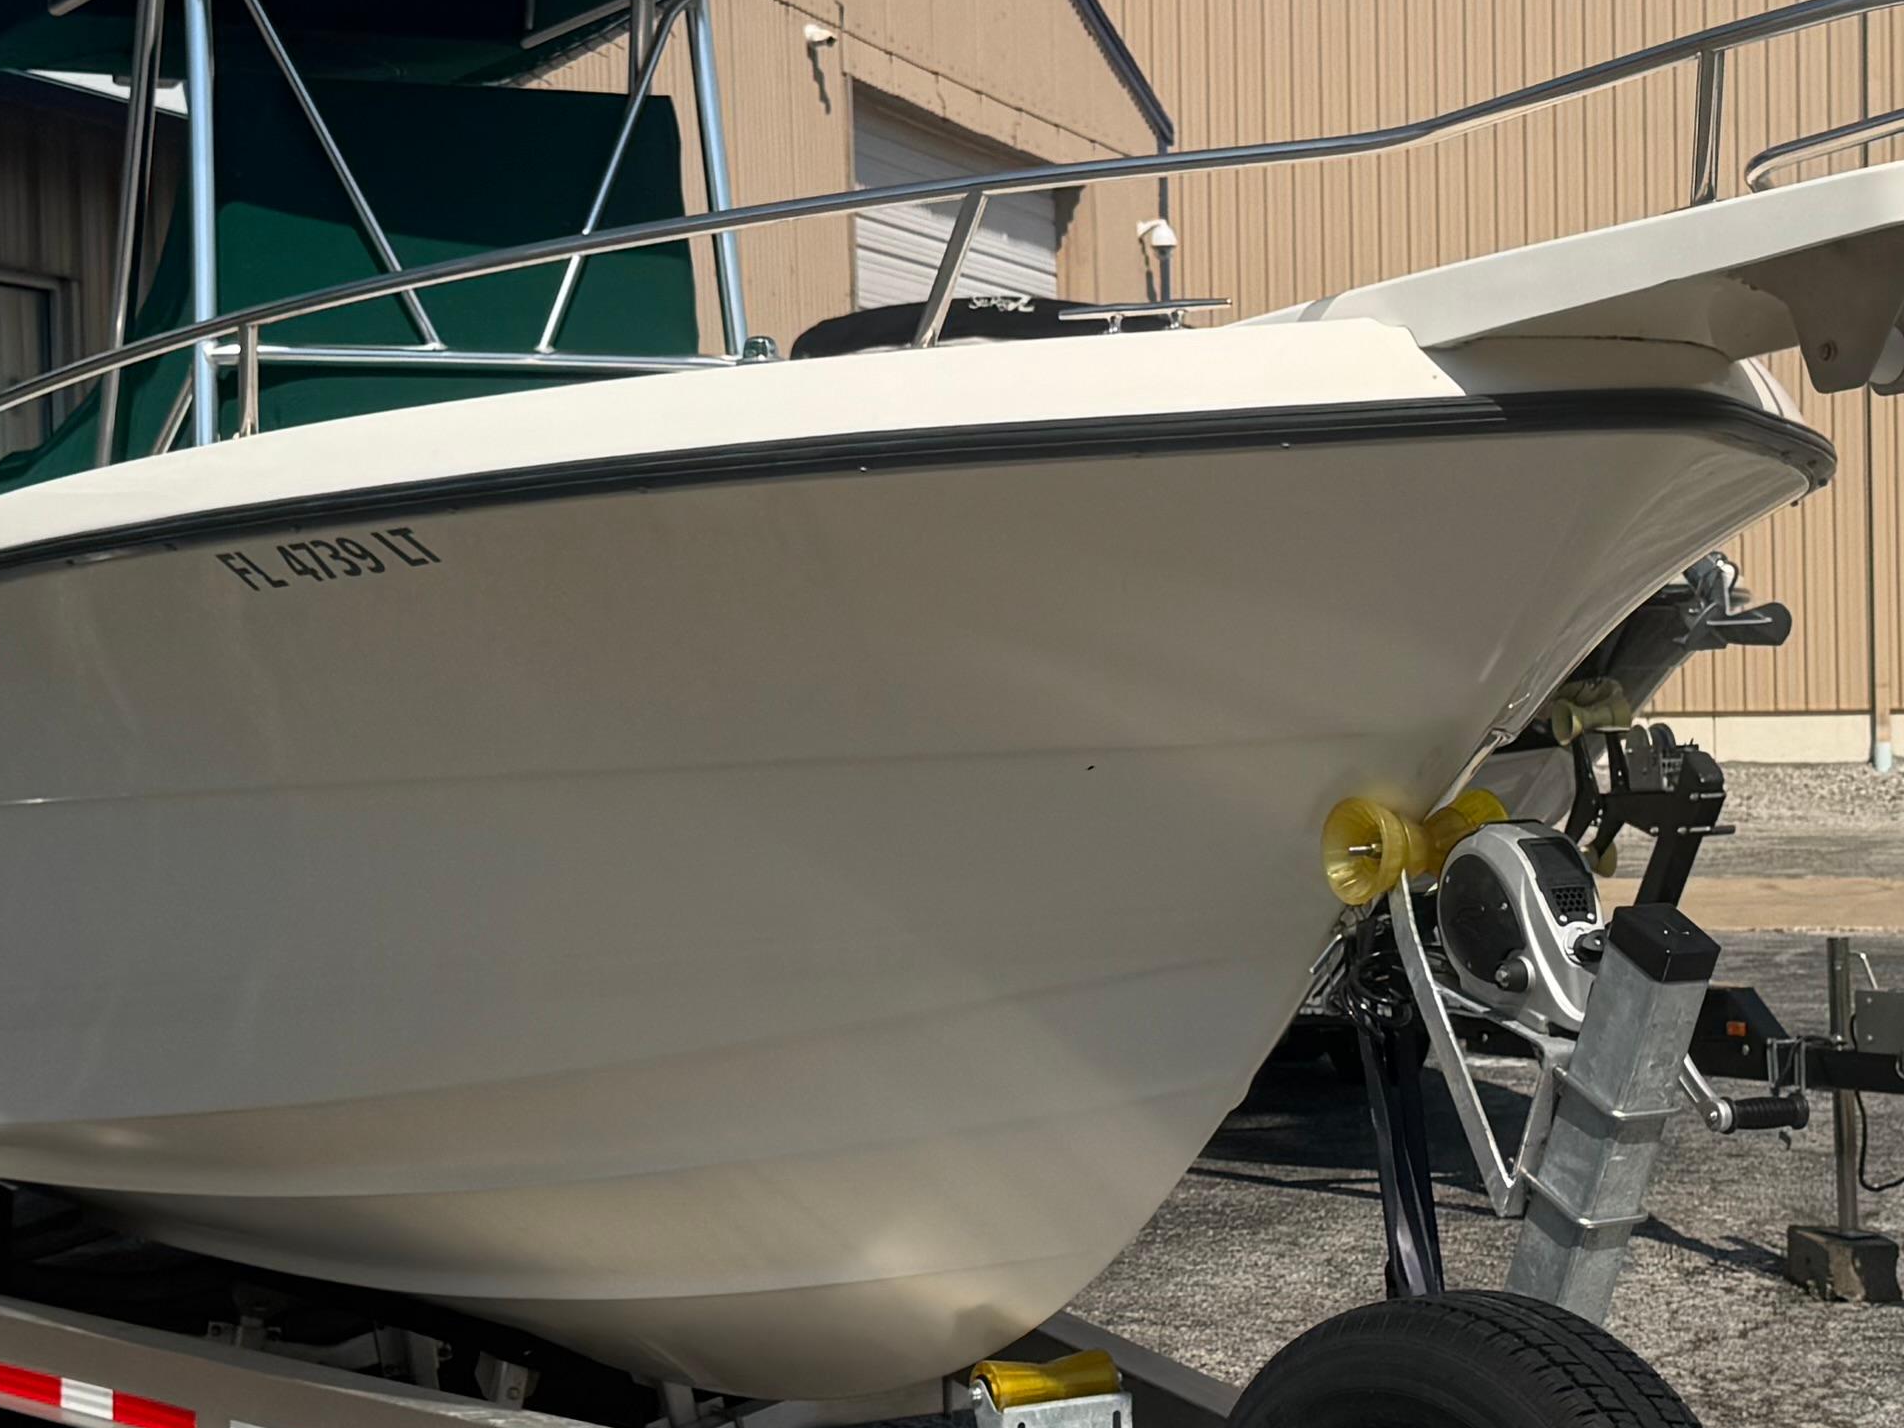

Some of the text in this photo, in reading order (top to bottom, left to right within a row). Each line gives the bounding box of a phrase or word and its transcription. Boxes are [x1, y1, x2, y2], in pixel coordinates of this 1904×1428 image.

[215, 527, 441, 591] FL 4739 LT
